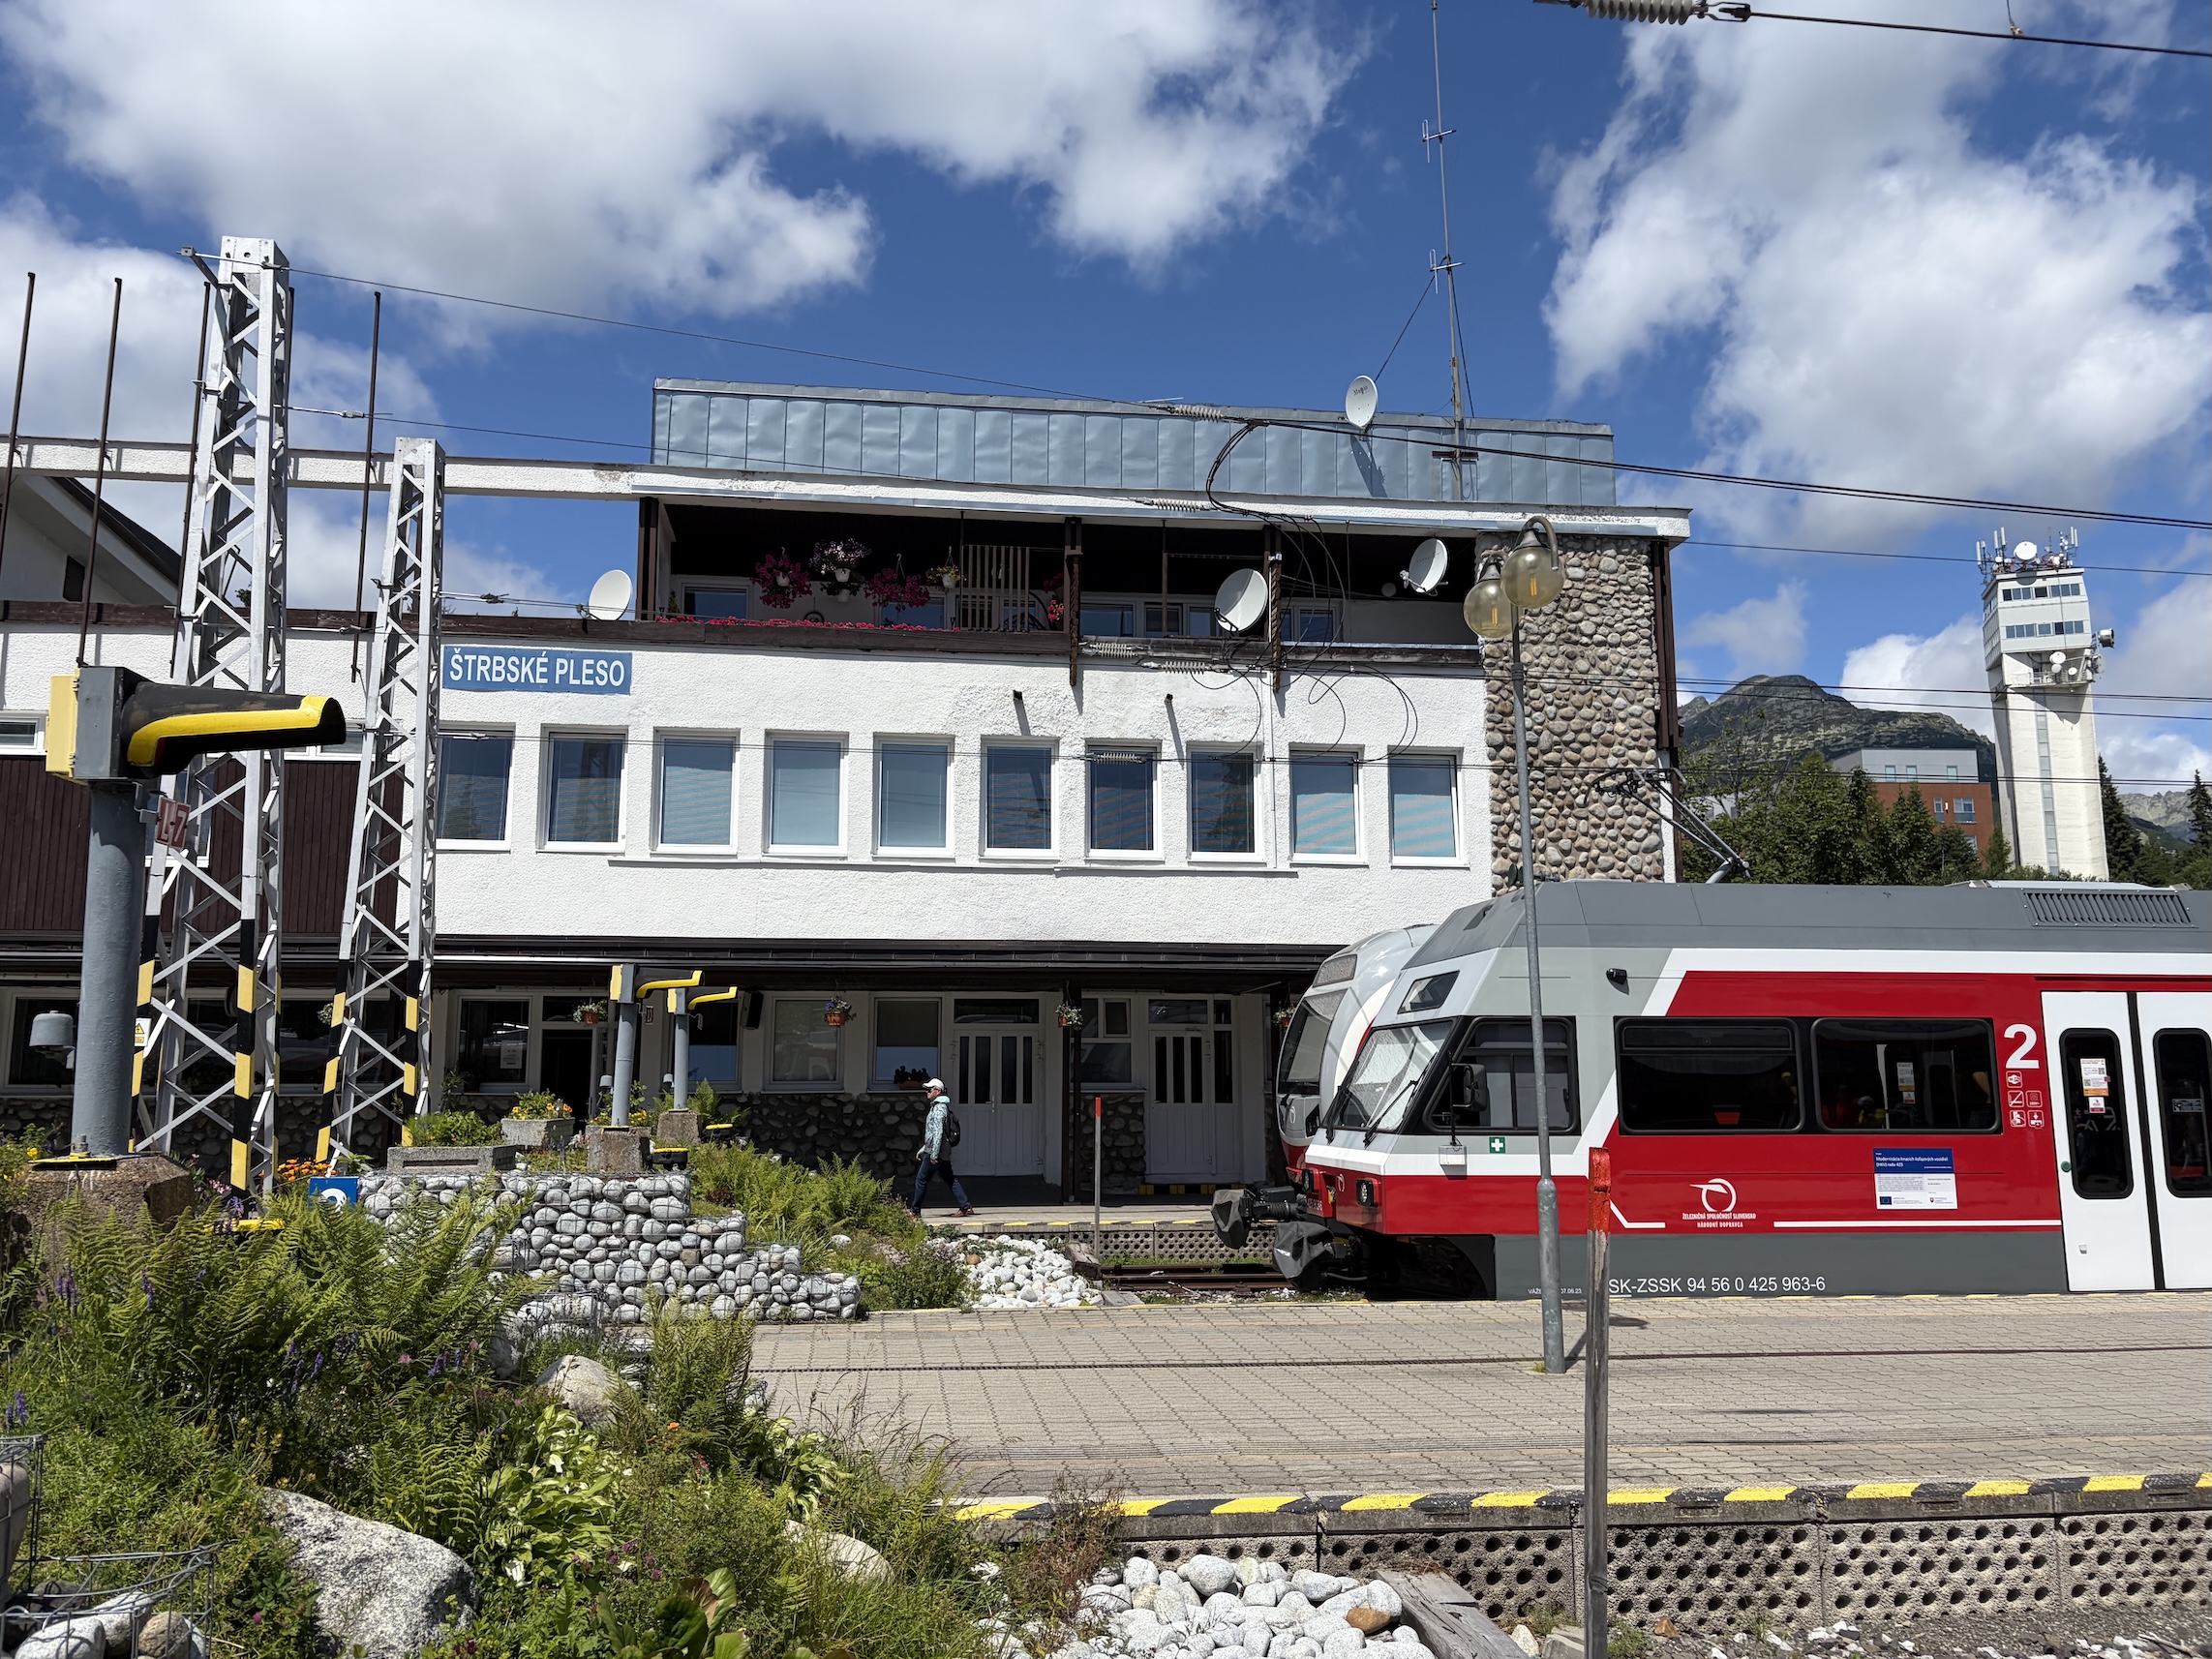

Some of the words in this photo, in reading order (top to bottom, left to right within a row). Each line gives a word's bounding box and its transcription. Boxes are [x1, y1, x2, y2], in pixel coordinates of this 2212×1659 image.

[449, 648, 549, 684] ŠTRBSKÉ
[555, 658, 625, 686] PLESO
[2003, 1023, 2040, 1070] 2
[1608, 1278, 1682, 1294] SK-ZSSK
[1686, 1277, 1707, 1292] 94
[1711, 1277, 1731, 1292] 56
[1734, 1277, 1744, 1292] 0
[1748, 1277, 1778, 1292] 425
[1782, 1276, 1826, 1291] 963-6
